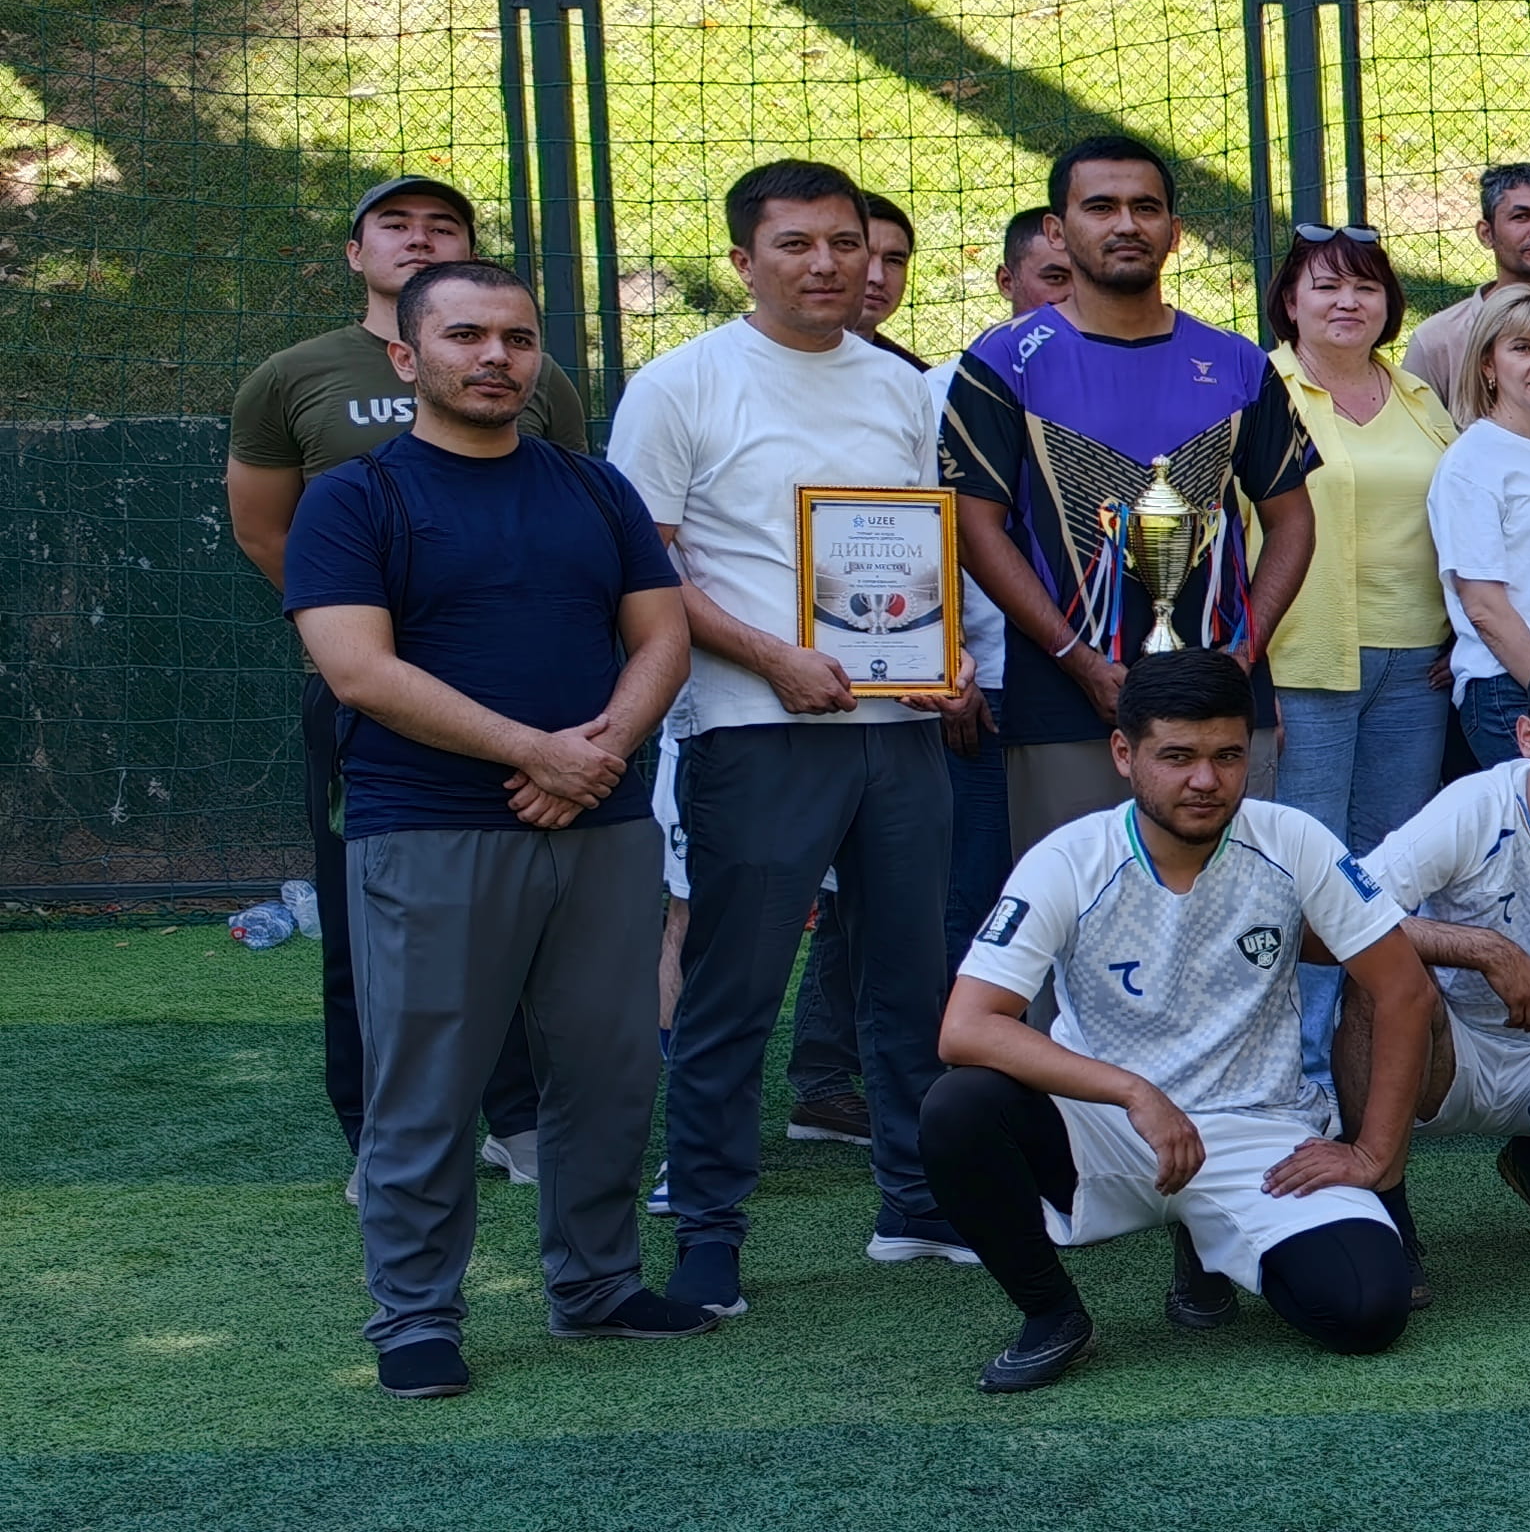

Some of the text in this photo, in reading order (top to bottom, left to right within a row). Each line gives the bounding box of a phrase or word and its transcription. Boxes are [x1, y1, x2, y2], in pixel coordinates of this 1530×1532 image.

[1012, 324, 1056, 374] LOKI
[348, 397, 419, 425] LUS
[867, 516, 896, 526] UZEE
[829, 542, 923, 559] ДИПЛОМ
[1242, 932, 1279, 954] UFA
